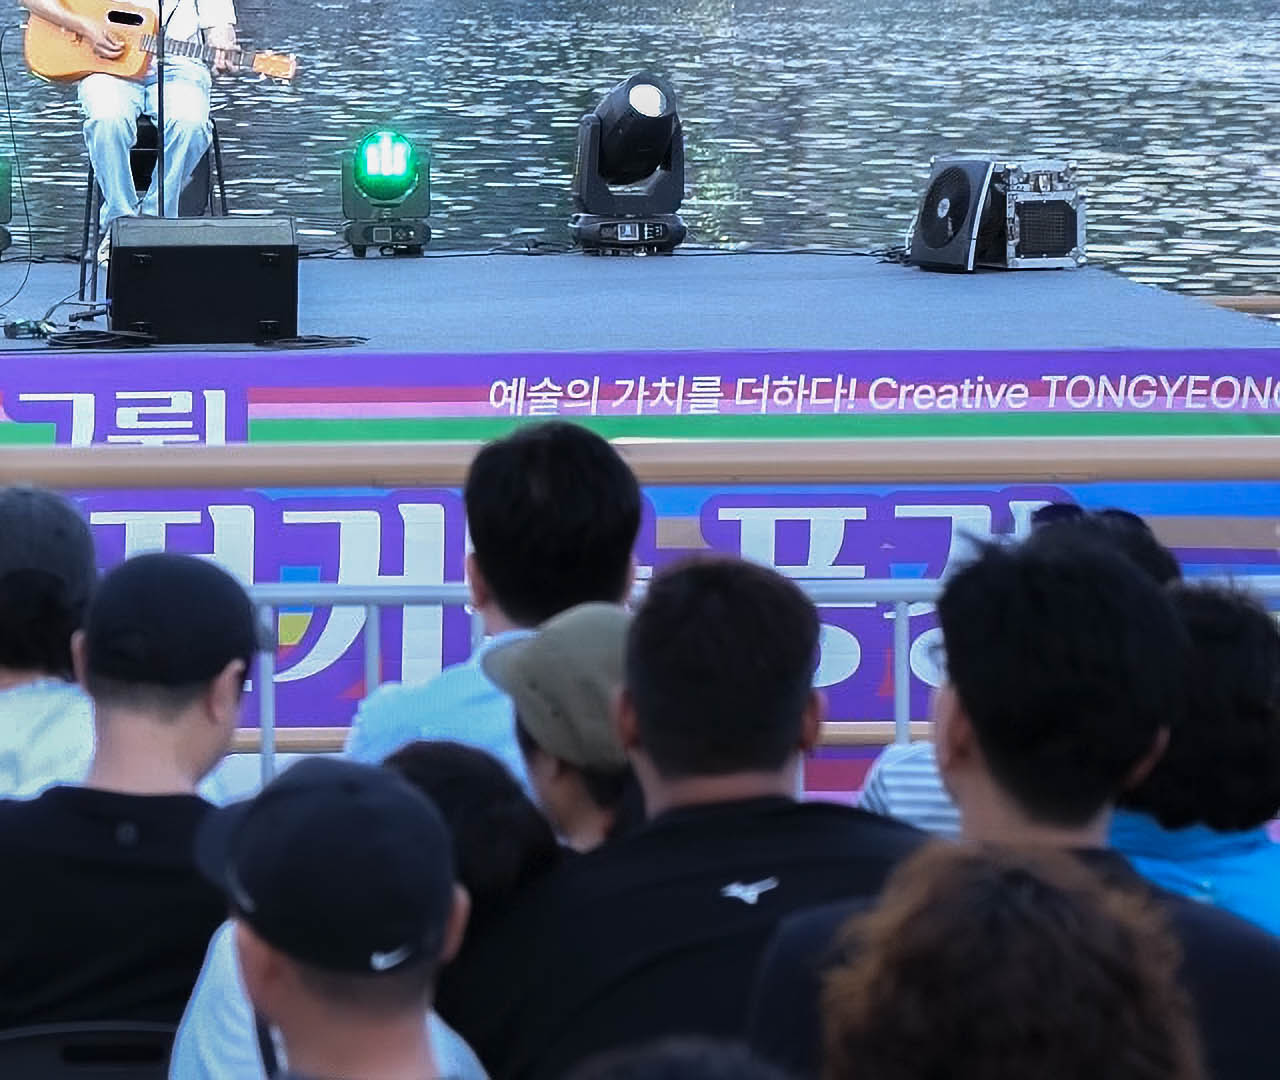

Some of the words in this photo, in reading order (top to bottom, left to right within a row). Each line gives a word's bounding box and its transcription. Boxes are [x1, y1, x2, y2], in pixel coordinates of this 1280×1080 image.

[489, 375, 600, 416] 예술의
[614, 375, 724, 414] 가치를
[735, 374, 856, 414] 더하다!
[868, 375, 1029, 410] Creative
